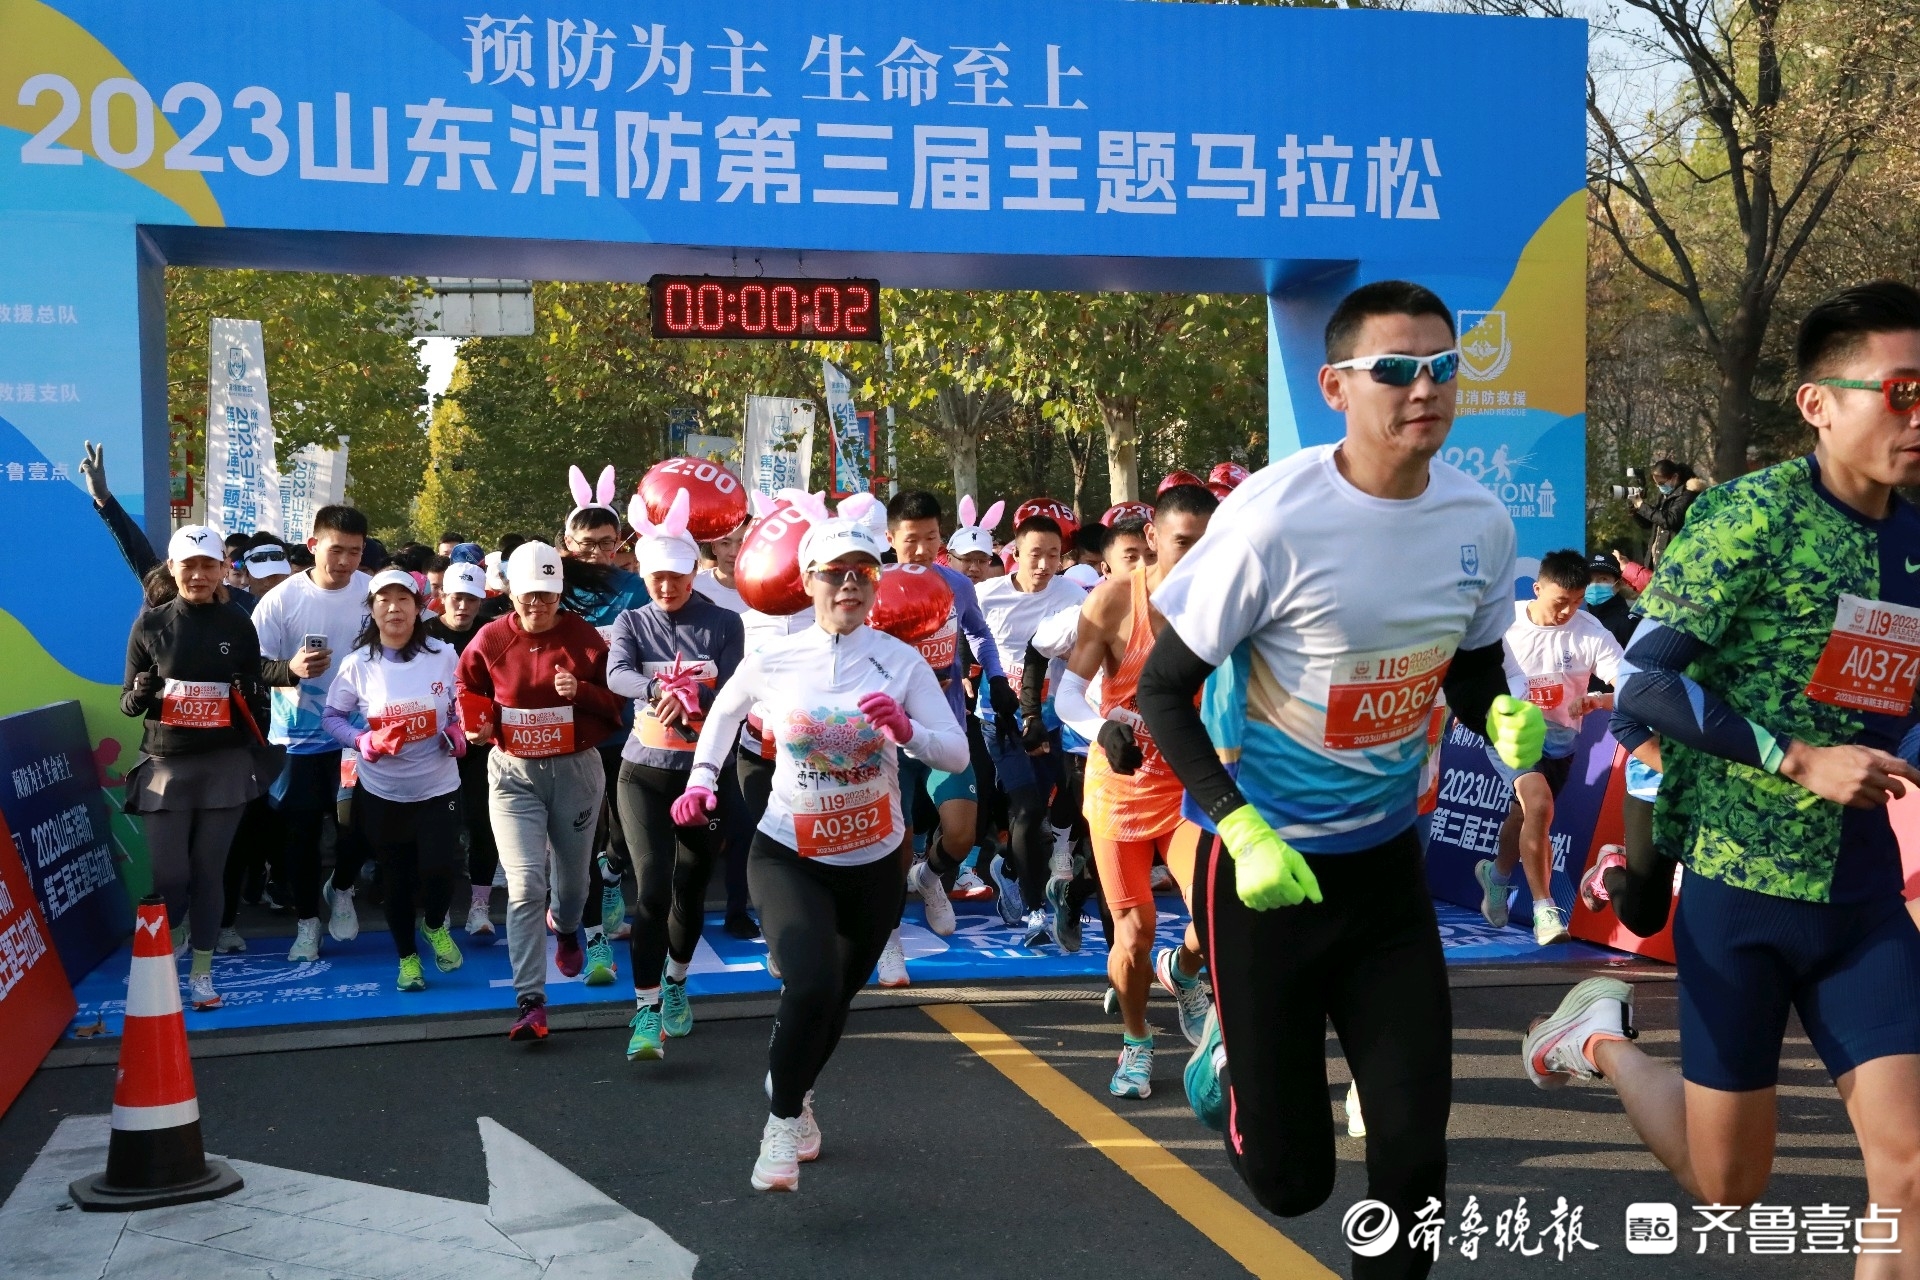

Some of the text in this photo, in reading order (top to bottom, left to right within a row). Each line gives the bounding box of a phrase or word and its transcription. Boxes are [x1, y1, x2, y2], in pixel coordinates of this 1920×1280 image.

[463, 15, 1089, 111] 预防为主 生命至上
[18, 73, 1442, 221] 2023山东消防第三届主题马拉松
[666, 284, 869, 332] 00:00:02
[1496, 408, 1527, 416] RESCUE
[0, 461, 70, 481] 鲁壹点
[660, 458, 737, 494] 2:00
[1866, 609, 1892, 636] 119
[1375, 656, 1410, 680] 119
[1839, 645, 1920, 687] A0374
[172, 699, 220, 716] A0372
[1352, 675, 1438, 722] A0262
[519, 713, 537, 725] 119
[511, 727, 563, 745] A0364
[819, 794, 846, 812] 119
[811, 807, 880, 839] A0362
